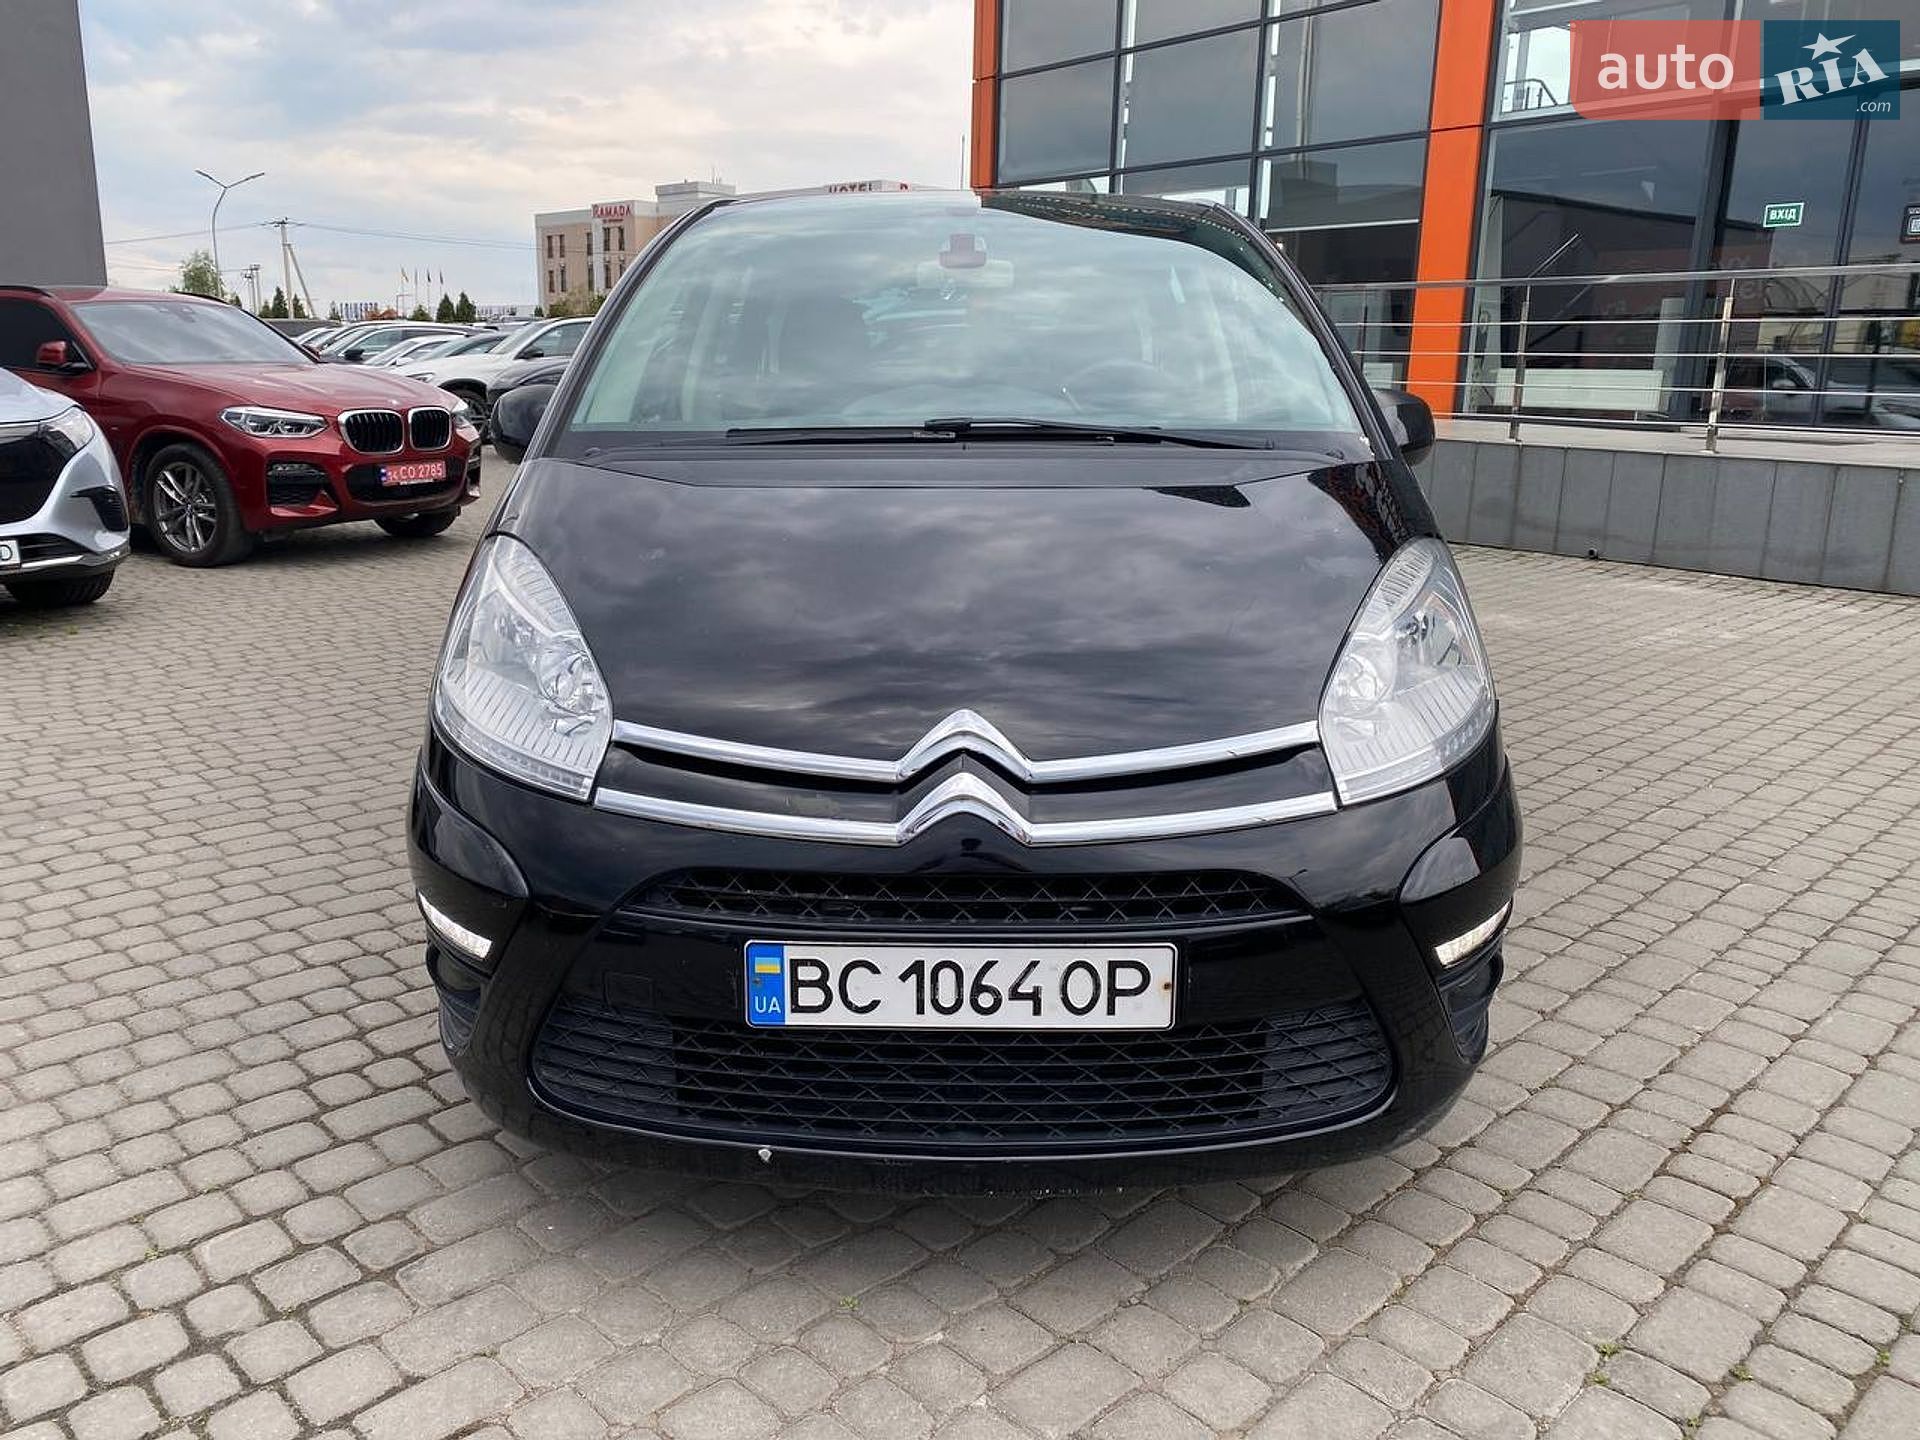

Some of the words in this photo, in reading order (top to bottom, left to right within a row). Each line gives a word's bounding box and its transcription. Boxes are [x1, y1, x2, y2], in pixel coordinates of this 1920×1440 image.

[592, 203, 630, 217] RAMADA
[790, 958, 881, 1014] BC
[898, 959, 1043, 1016] 1064
[1060, 959, 1151, 1016] OP
[755, 996, 781, 1013] UA
